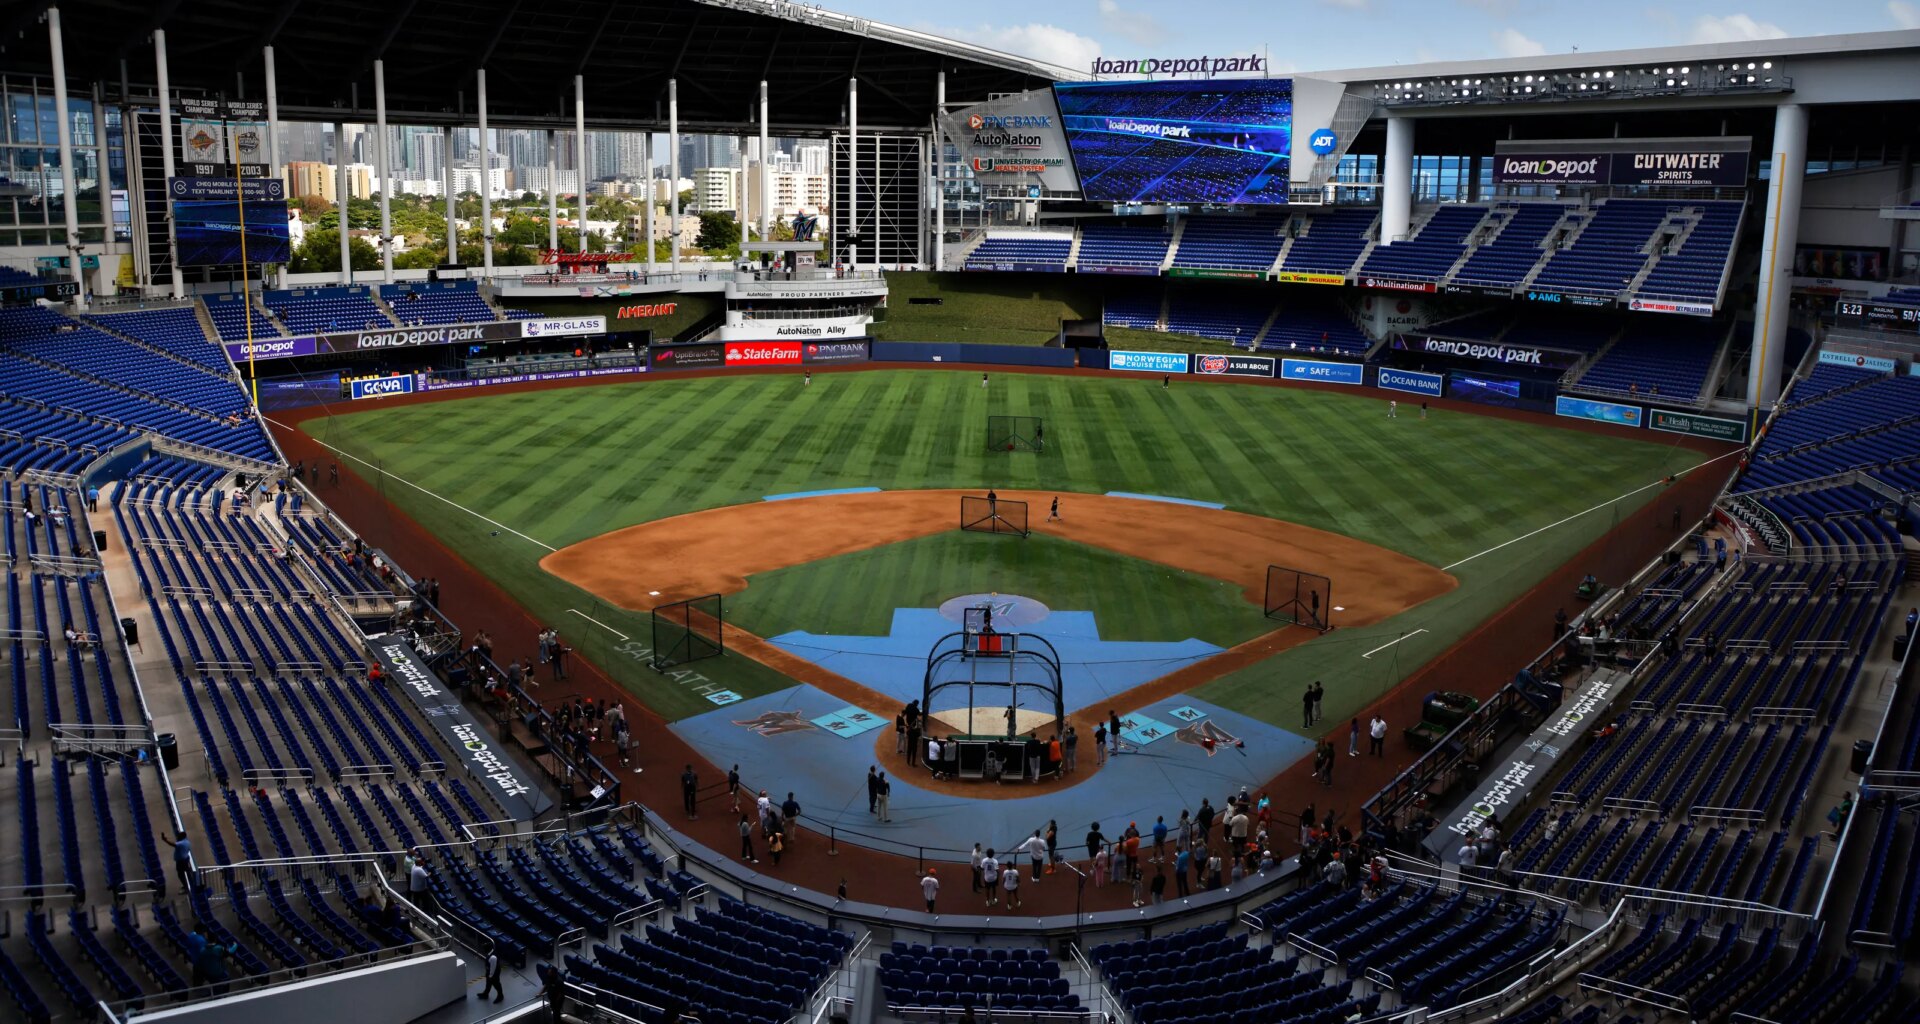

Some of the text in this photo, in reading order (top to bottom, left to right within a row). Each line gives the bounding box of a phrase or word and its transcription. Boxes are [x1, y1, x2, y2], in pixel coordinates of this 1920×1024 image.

[1095, 54, 1263, 77] loanDepot park
[181, 98, 218, 108] WORLD SERIES
[227, 101, 246, 109] WORLD
[185, 106, 215, 114] CHAMPIONS
[984, 115, 1052, 128] PNC BANK
[1108, 120, 1191, 138] loanDepot park
[973, 133, 1041, 145] AutoNation
[1313, 136, 1333, 147] ADT
[1634, 154, 1720, 169] CUTWATER
[195, 164, 214, 175] 1997
[240, 165, 261, 176] 2003
[1503, 158, 1598, 178] loanDepot
[1658, 171, 1693, 180] SPIRITS
[56, 285, 76, 296] 5:23
[1375, 279, 1426, 291] Multinational
[1538, 293, 1561, 302] AMG
[617, 303, 677, 319] AMERANT
[1842, 304, 1863, 315] 5:23
[357, 324, 484, 349] loanDepot park
[777, 326, 846, 335] AutoNation Alley
[240, 340, 295, 355] loanDepot
[840, 342, 865, 352] BANK
[1424, 337, 1543, 364] loanDepot park
[1126, 355, 1185, 364] NORWEGIAN
[1822, 353, 1893, 368] ESTRELLA JALISCO
[1310, 367, 1330, 376] SAFE
[363, 379, 401, 394] GOYA
[1390, 376, 1440, 390] OCEAN BANK
[382, 644, 442, 698] loanDepot park
[1546, 680, 1613, 736] loanDepot park
[450, 723, 530, 797] loanDepot park
[1448, 760, 1536, 836] loanDepot park
